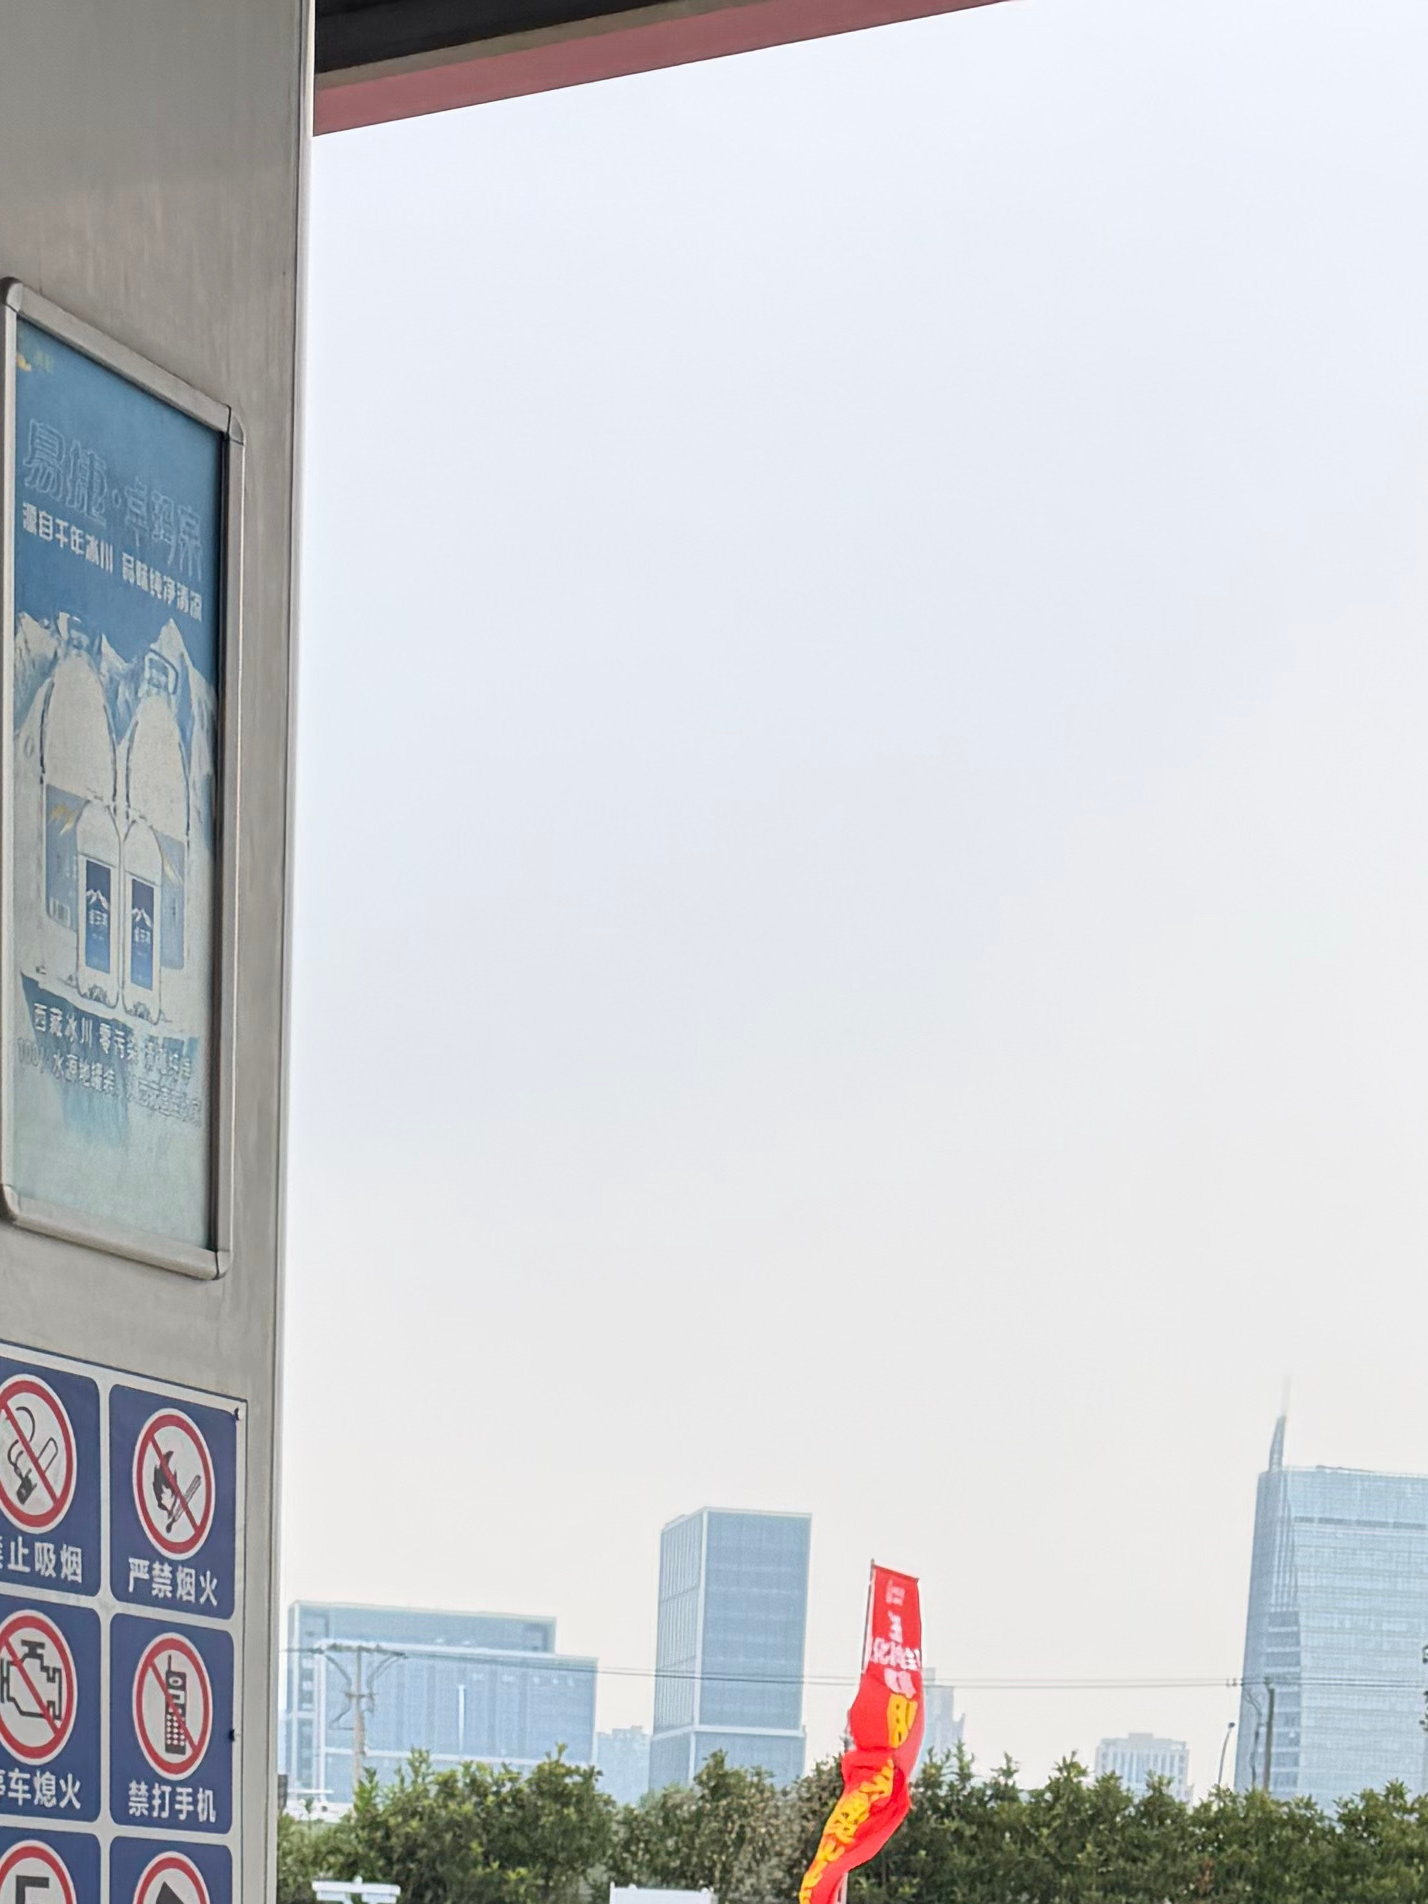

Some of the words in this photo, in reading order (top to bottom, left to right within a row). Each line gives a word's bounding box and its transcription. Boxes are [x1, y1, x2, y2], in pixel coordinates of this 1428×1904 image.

[128, 1557, 218, 1607] 严禁烟火
[128, 1782, 217, 1823] 禁打手机
